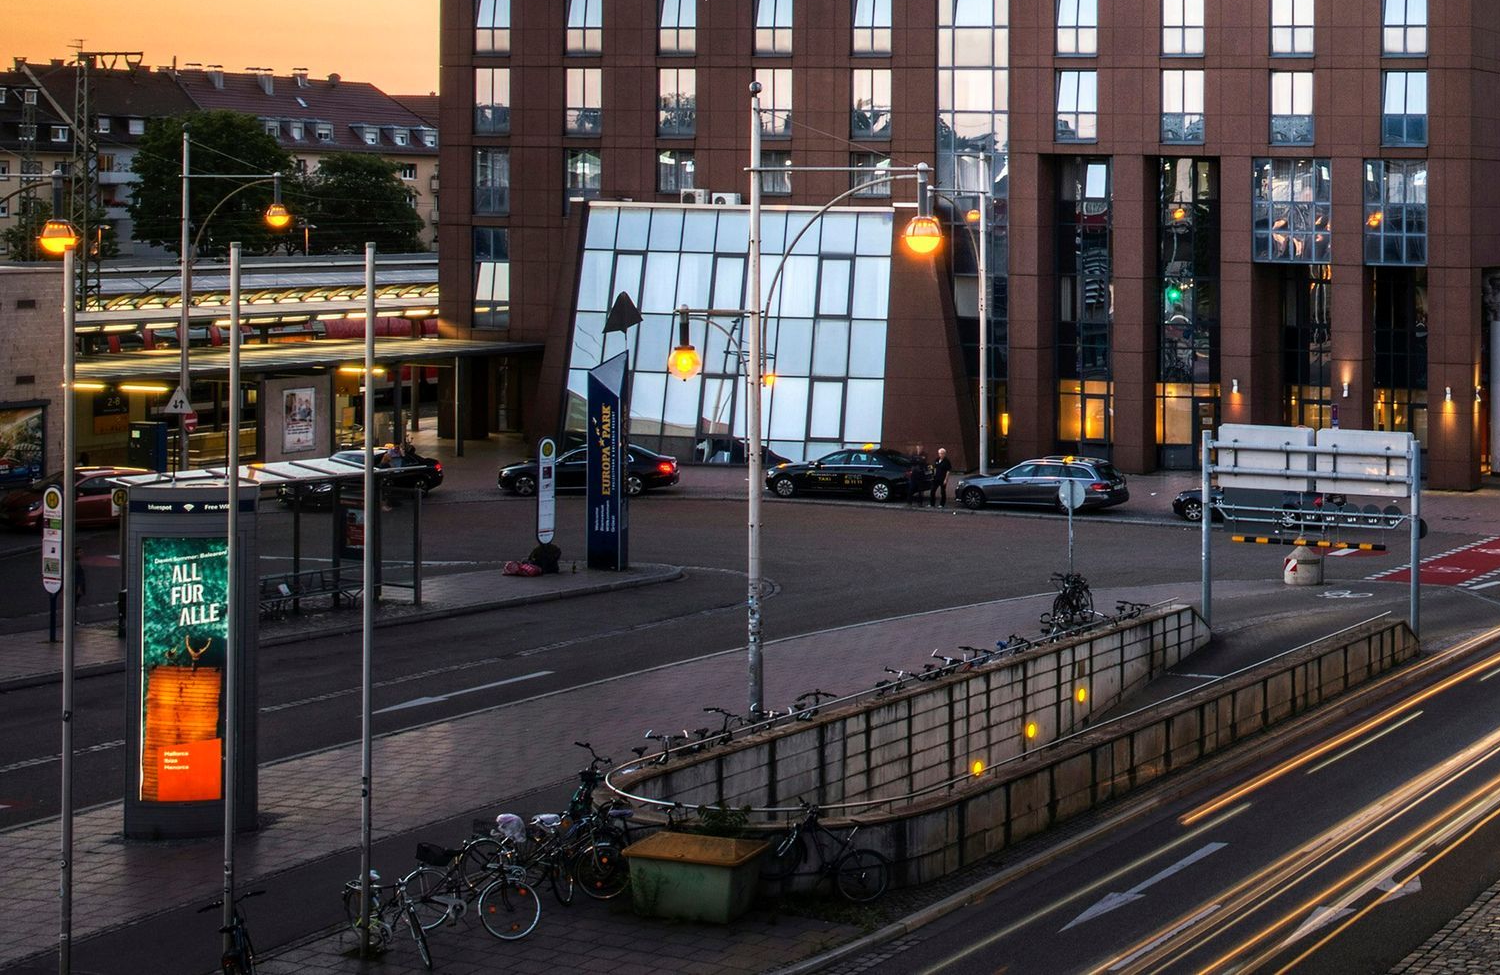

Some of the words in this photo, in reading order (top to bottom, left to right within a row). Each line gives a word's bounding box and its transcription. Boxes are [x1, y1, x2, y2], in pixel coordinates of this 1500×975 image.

[602, 405, 612, 438] PARK
[602, 448, 612, 495] EUROPA
[172, 562, 202, 584] ALL
[171, 583, 204, 606] FÜR
[179, 603, 220, 627] ALLE
